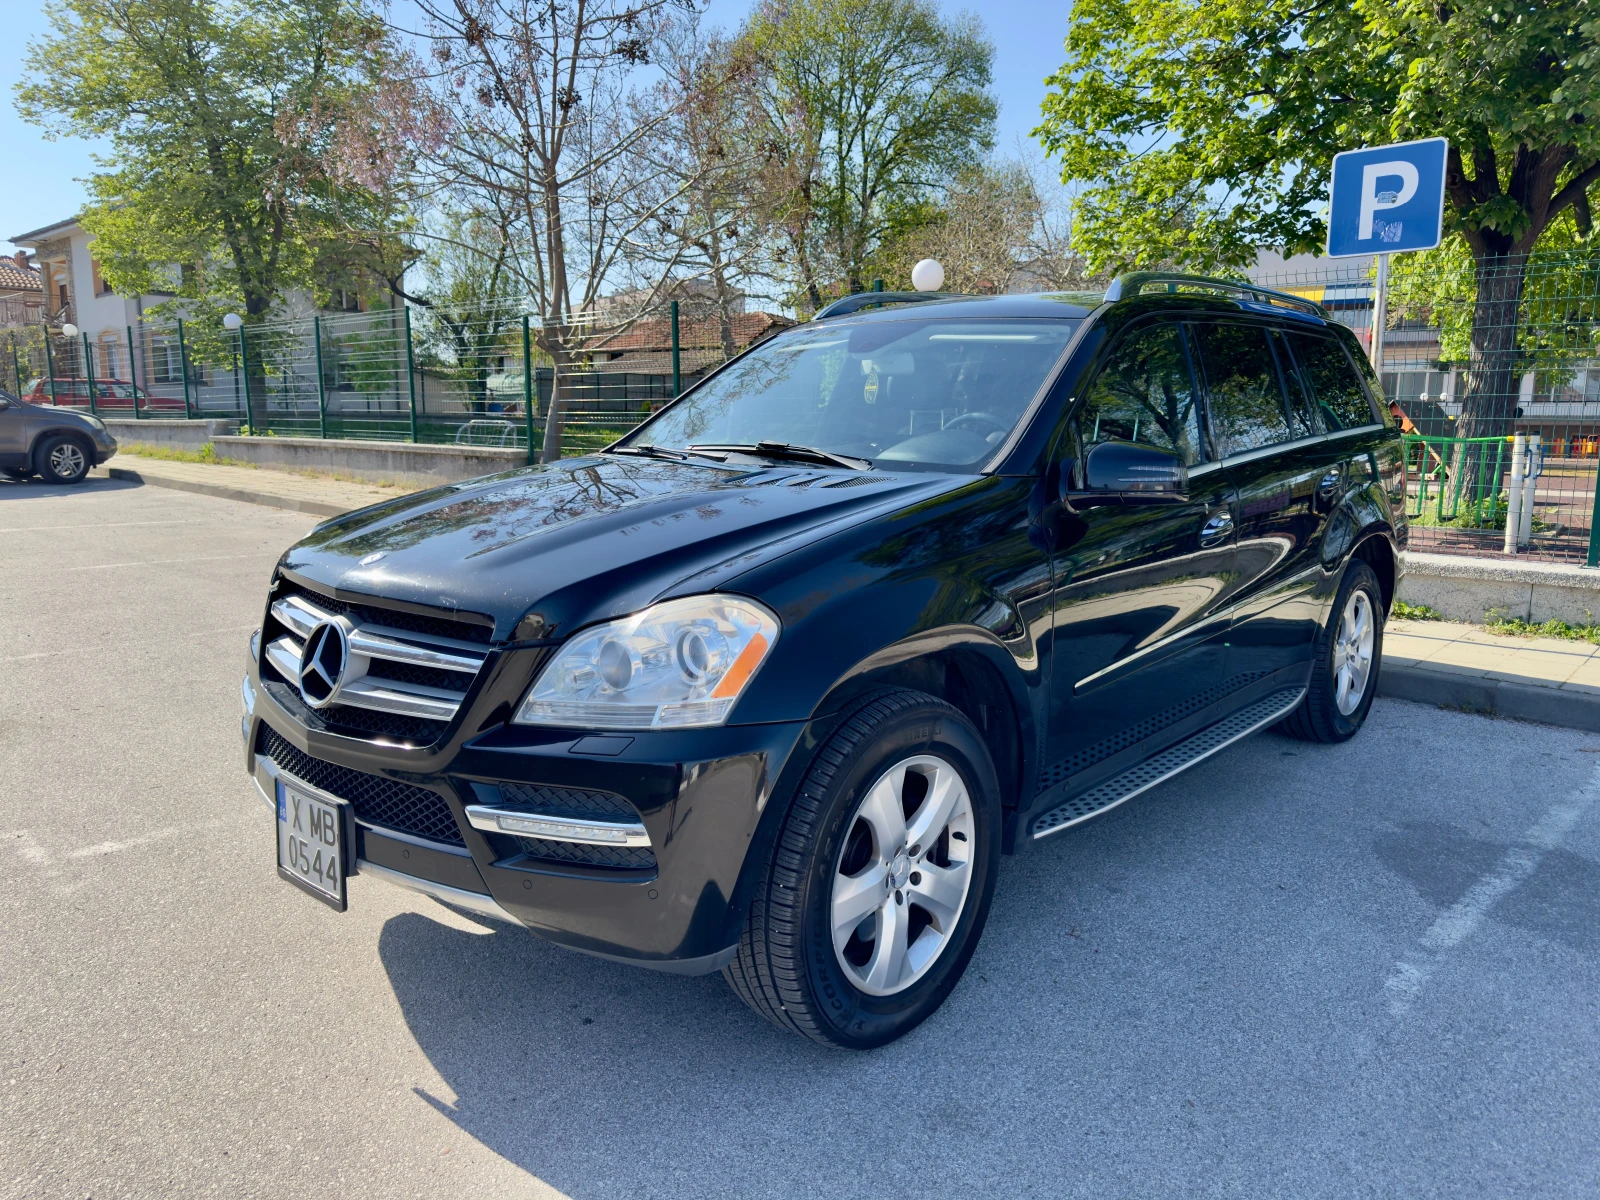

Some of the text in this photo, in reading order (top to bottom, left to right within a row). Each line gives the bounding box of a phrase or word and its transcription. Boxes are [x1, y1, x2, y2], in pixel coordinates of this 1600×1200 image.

[1358, 160, 1420, 240] P
[291, 793, 336, 847] X MB
[288, 833, 338, 891] 0544
